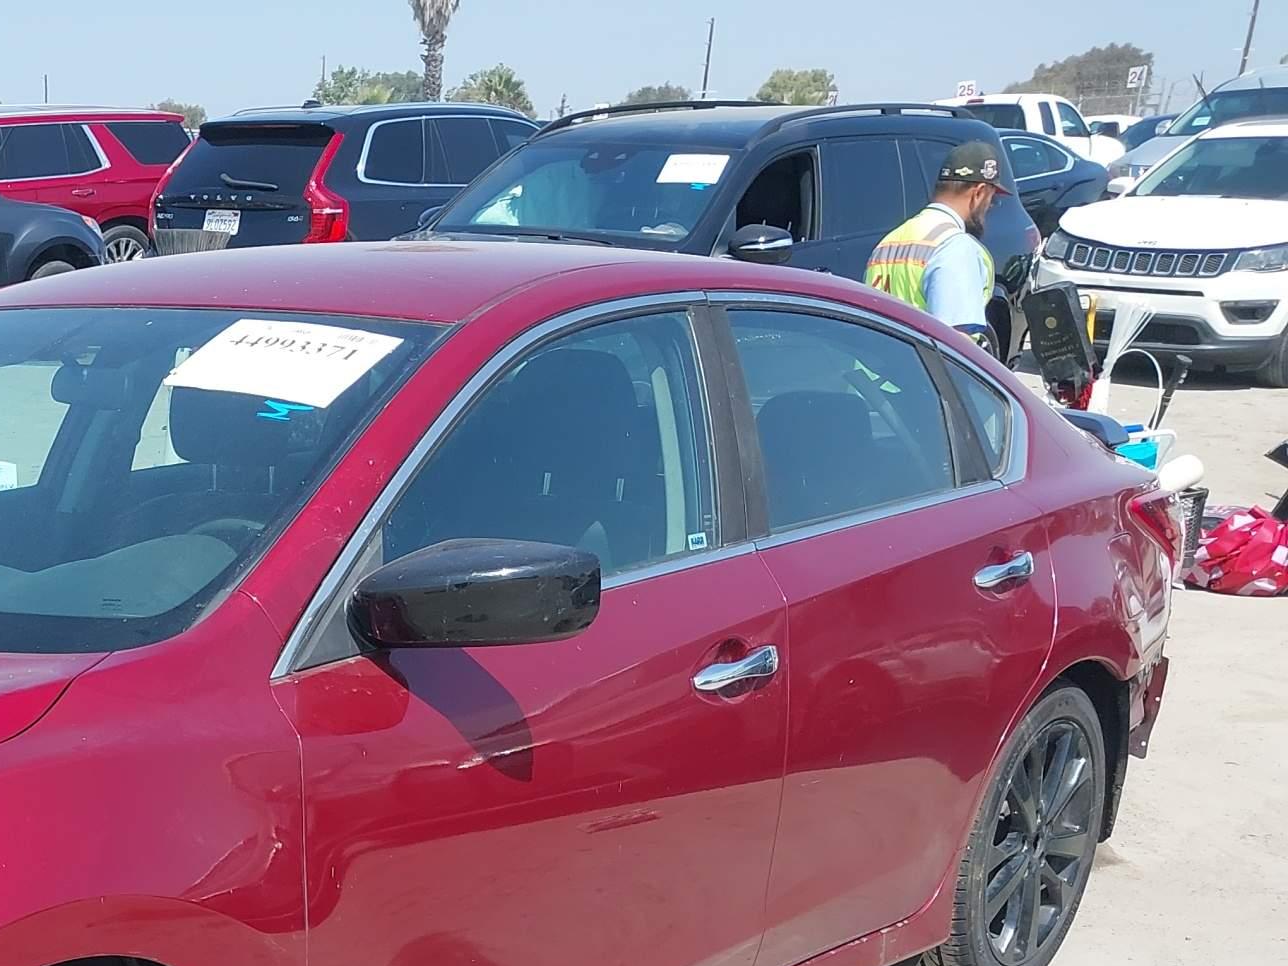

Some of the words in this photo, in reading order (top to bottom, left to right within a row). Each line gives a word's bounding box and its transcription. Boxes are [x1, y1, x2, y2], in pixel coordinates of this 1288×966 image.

[958, 84, 975, 97] 25
[189, 194, 253, 202] VOLVO
[229, 333, 359, 361] 44993371
